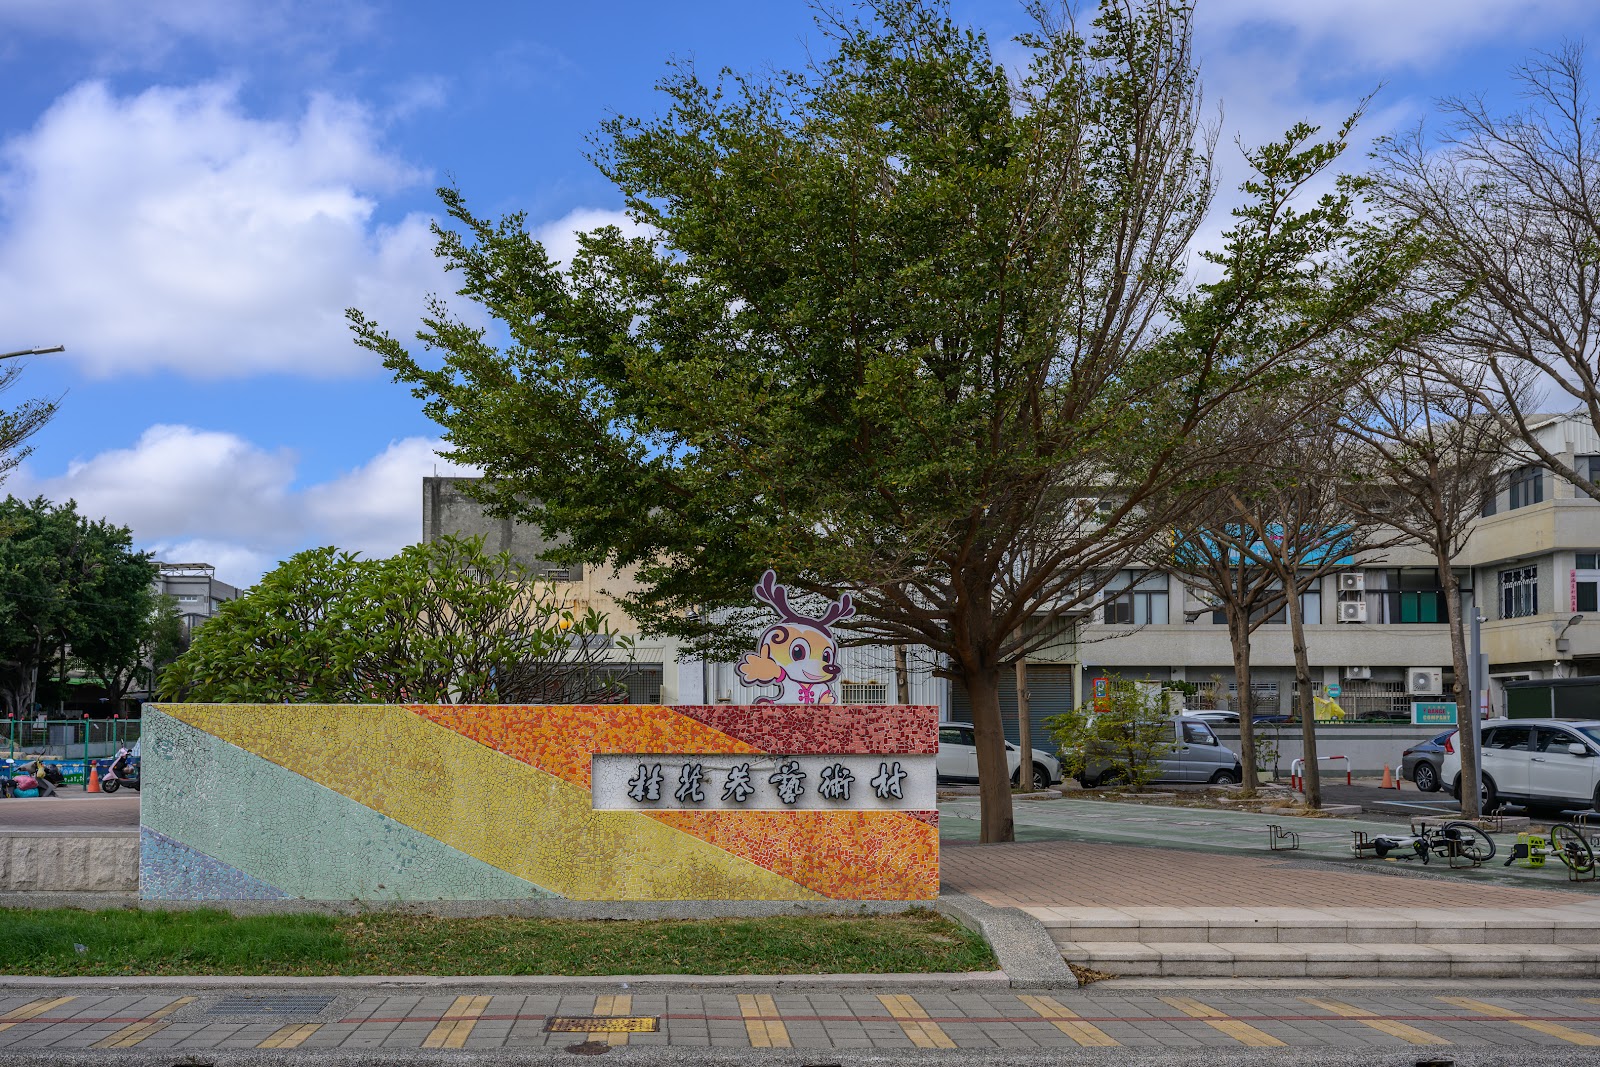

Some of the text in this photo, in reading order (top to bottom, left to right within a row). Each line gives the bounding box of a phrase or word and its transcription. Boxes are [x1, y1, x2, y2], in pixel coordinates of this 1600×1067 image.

[628, 761, 907, 803] 桂花巷藝術村
